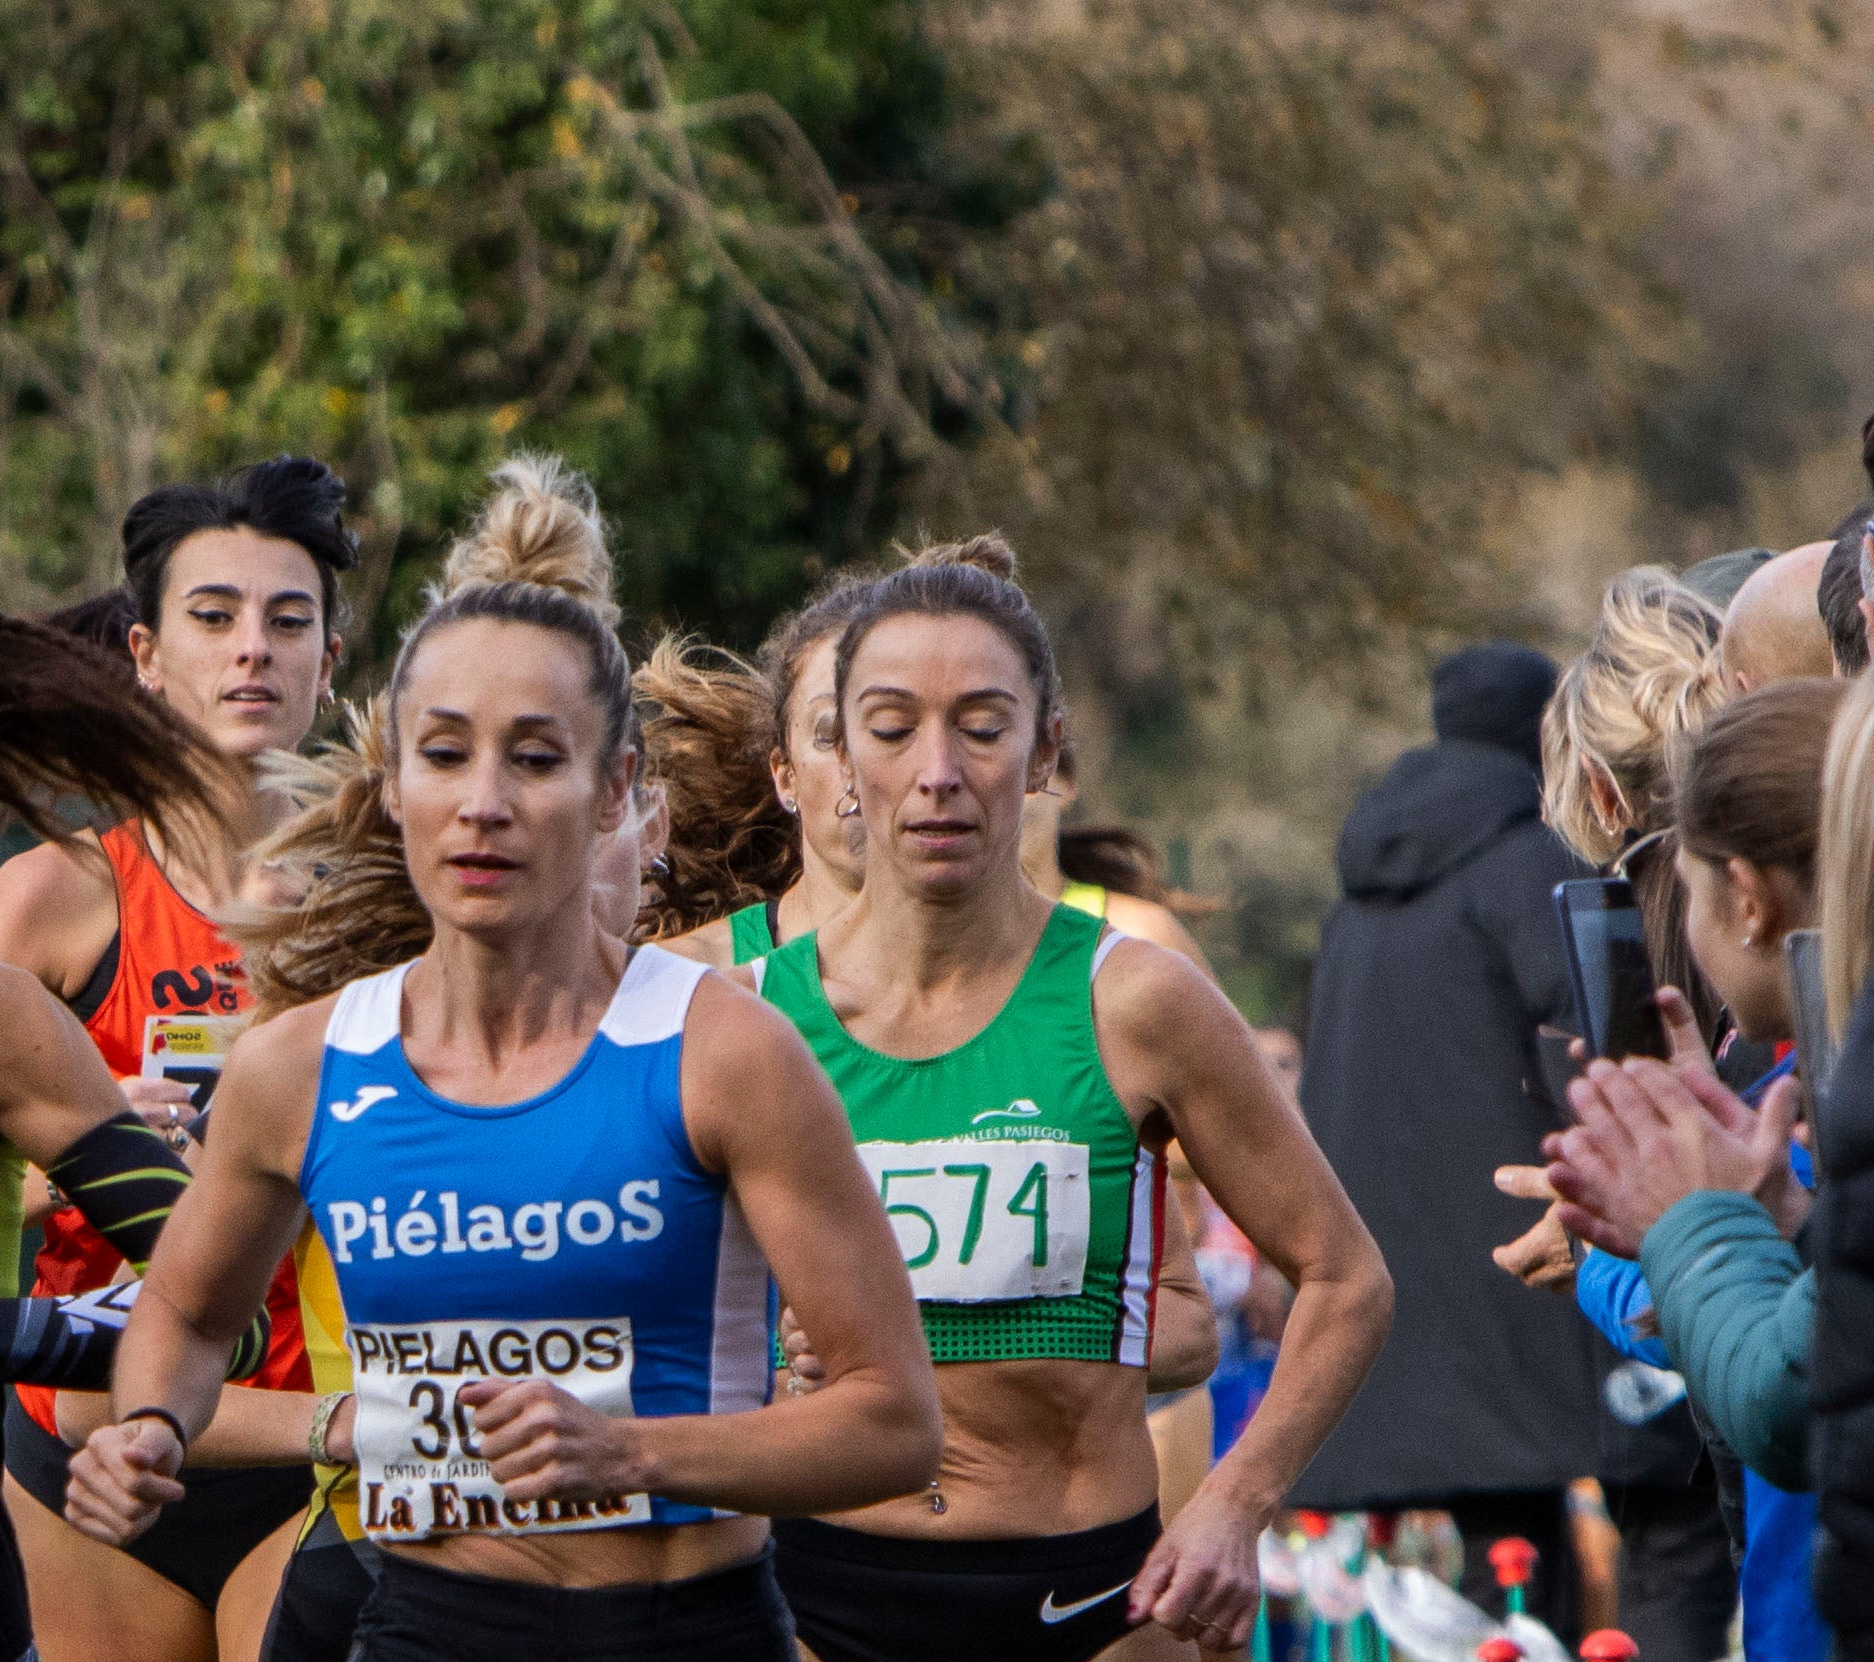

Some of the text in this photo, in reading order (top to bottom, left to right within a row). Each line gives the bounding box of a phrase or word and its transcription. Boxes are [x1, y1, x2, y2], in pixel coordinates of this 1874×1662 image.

[1004, 1124, 1070, 1141] PASIEGOS
[879, 1161, 1049, 1271] 574
[353, 1327, 627, 1376] PIELAGOS
[384, 1464, 426, 1480] CENTRO
[365, 1482, 417, 1532] La
